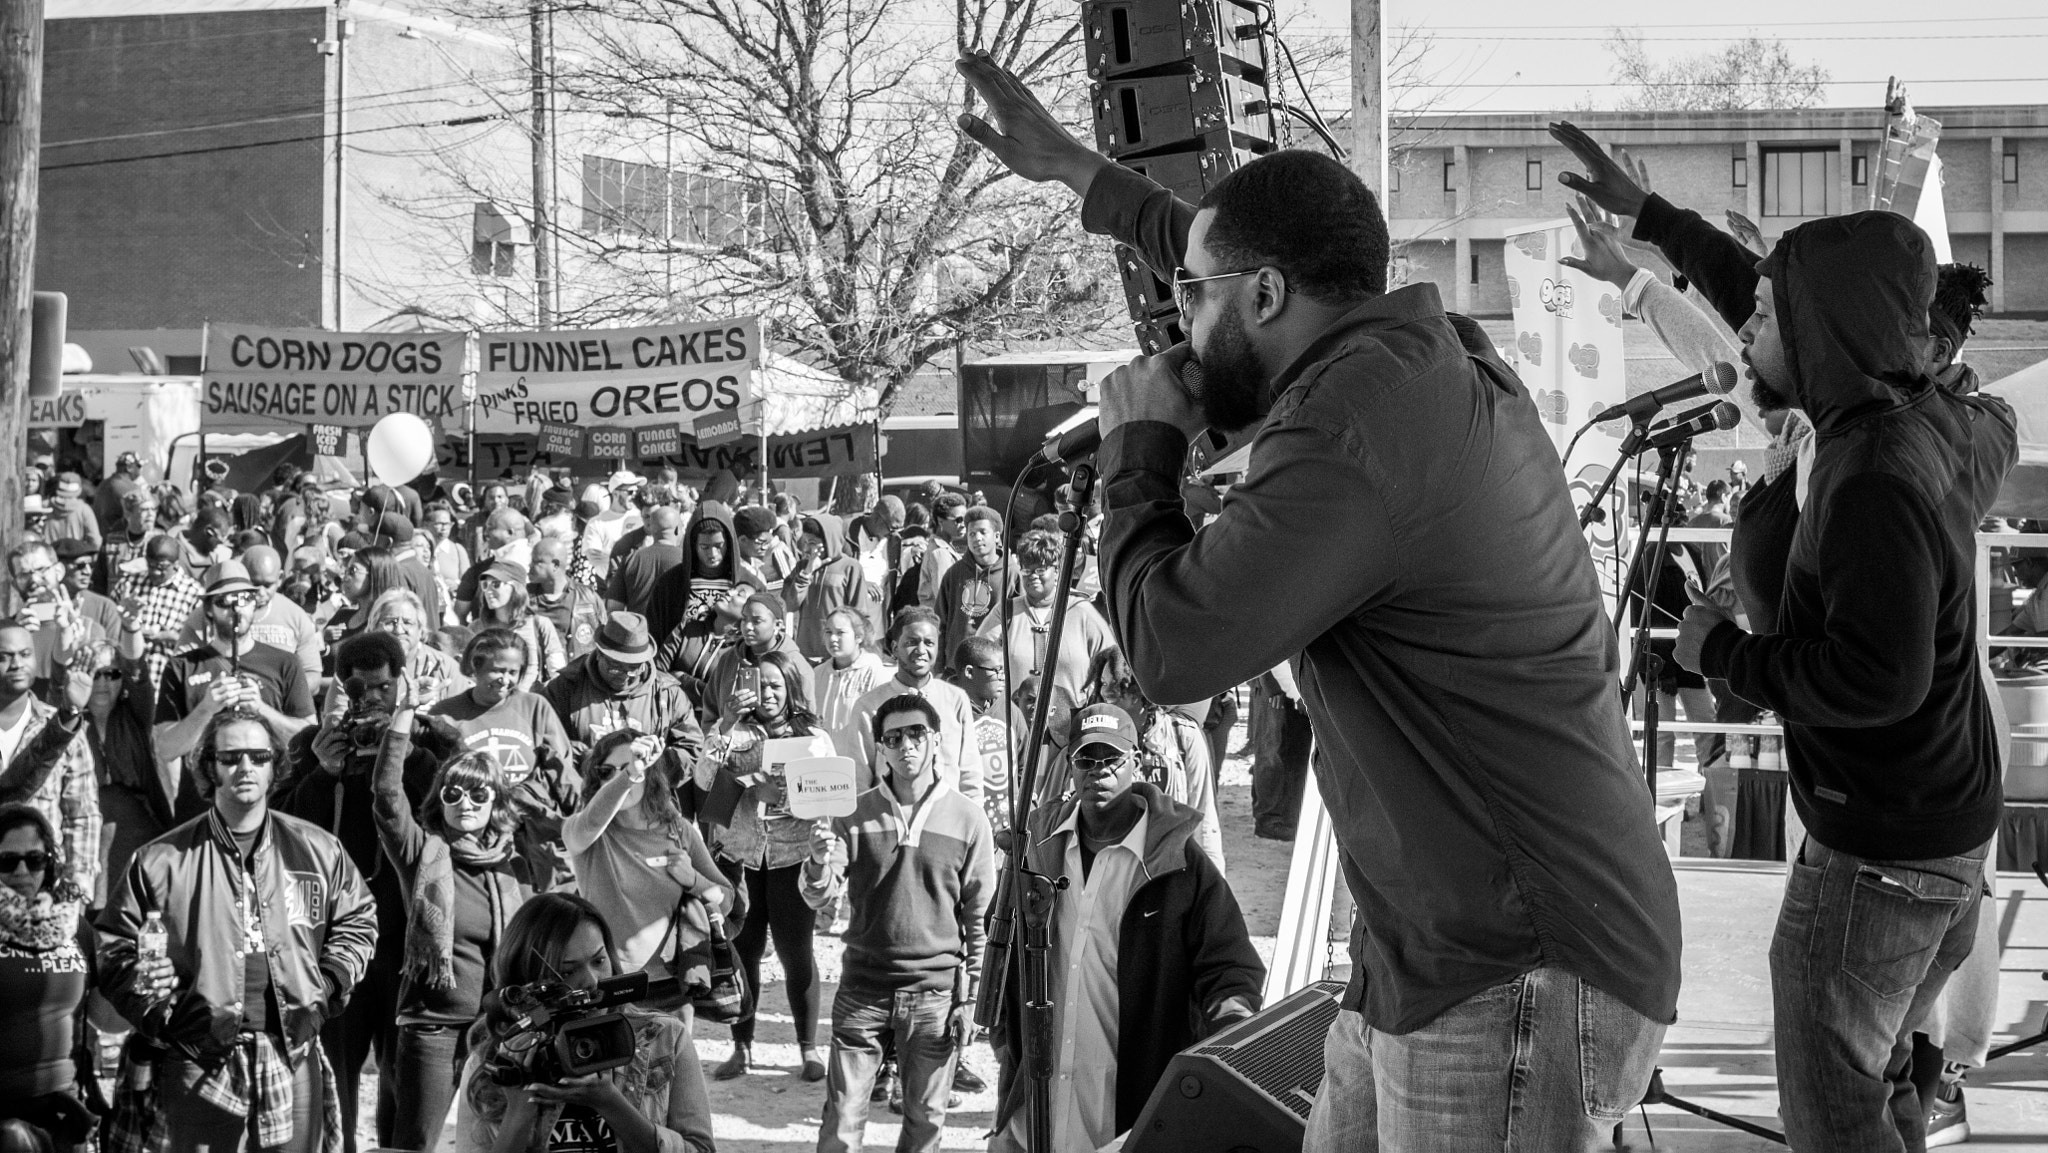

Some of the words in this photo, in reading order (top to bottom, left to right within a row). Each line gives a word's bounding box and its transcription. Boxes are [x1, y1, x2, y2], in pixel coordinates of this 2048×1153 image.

[231, 334, 331, 371] CORN
[340, 341, 442, 374] DOGS
[489, 339, 623, 372] FUNNEL
[632, 327, 747, 369] CAKES
[208, 381, 316, 415] SAUSAGE
[323, 383, 357, 416] ON
[363, 384, 379, 416] A
[386, 384, 455, 417] STICK
[479, 376, 528, 419] PINKS
[590, 375, 741, 418] OREOS
[513, 401, 578, 425] FRIED
[313, 424, 342, 437] FRESH
[542, 424, 580, 438] SAUSAGE
[637, 427, 678, 443] FUNNEL
[696, 419, 739, 440] LEMONADE
[316, 435, 338, 446] ICED
[549, 435, 563, 445] ON
[564, 436, 571, 446] A
[592, 432, 627, 444] CORN
[318, 444, 335, 455] TEA
[546, 443, 572, 456] STICK
[593, 445, 626, 457] DOGS
[640, 441, 677, 456] CAKES
[829, 784, 850, 792] MOB
